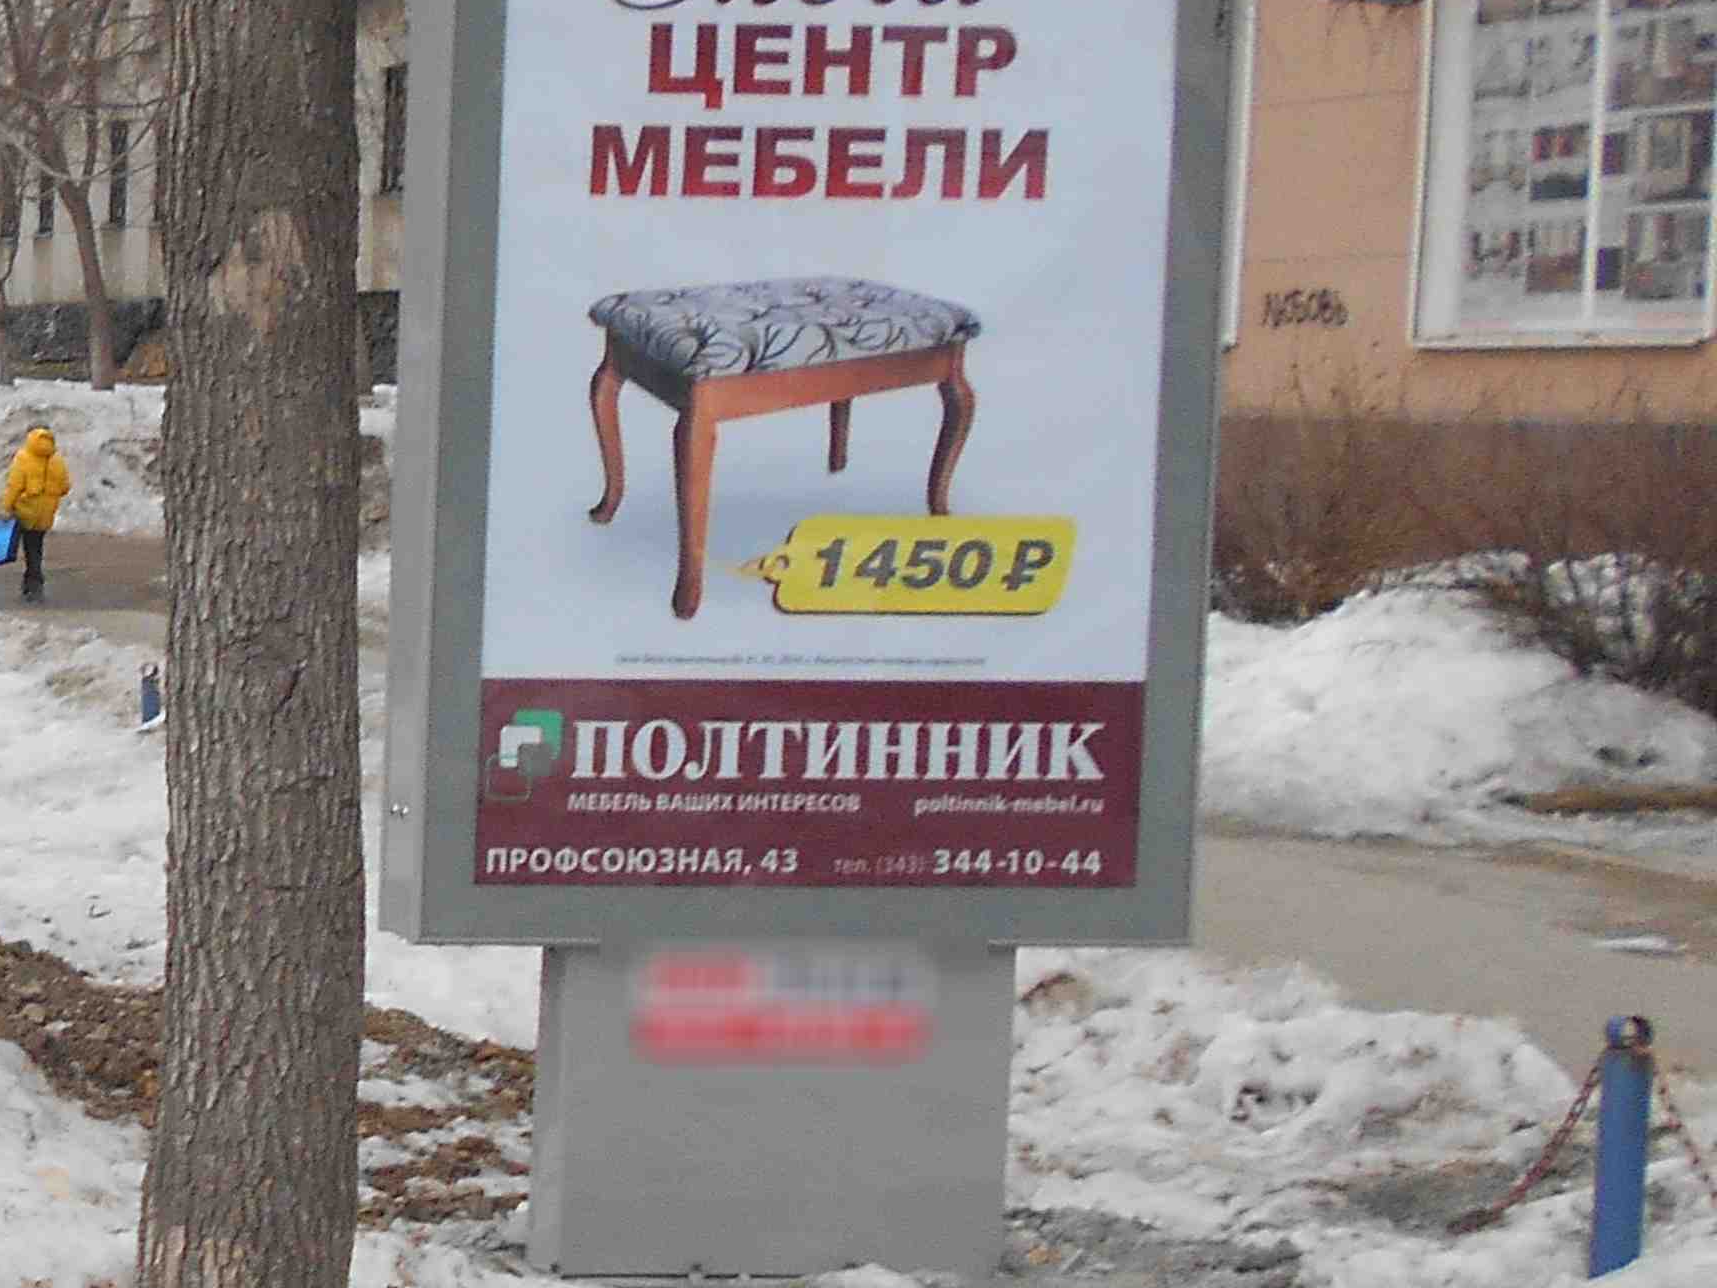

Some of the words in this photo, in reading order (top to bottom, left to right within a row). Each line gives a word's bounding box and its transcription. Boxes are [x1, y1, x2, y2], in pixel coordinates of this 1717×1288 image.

[647, 22, 1019, 111] ЦЕНТР
[588, 124, 1051, 201] МЕБЕЛИ
[570, 718, 1106, 781] ПОЛТИННИК
[567, 791, 652, 812] МЕБЕЛЬ
[656, 791, 734, 812] ВАШИХ
[737, 792, 862, 813] ИНТЕРЕСОВ
[914, 793, 1106, 817] poltinnik-mebel.ru
[484, 847, 752, 876] ПРОФСОЮЗНАЯ,
[760, 847, 799, 874] 43
[931, 848, 1103, 875] 344-10-44
